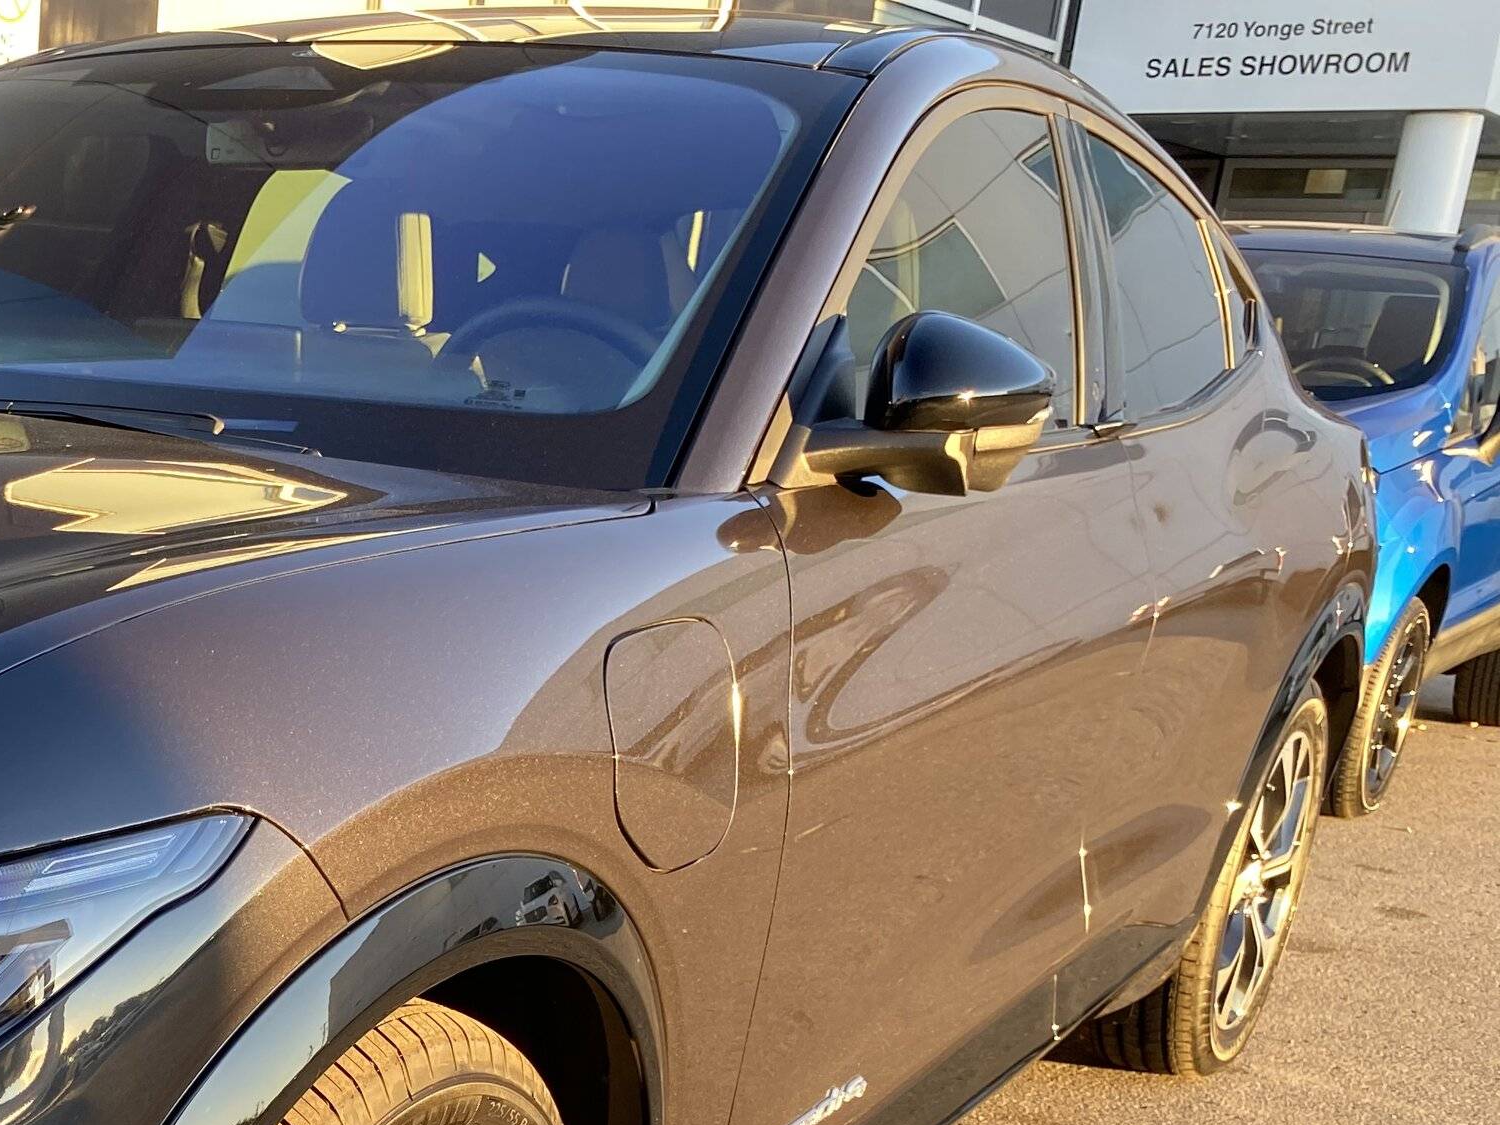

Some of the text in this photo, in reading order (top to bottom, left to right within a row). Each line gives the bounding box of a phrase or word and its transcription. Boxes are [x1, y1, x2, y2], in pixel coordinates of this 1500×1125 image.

[1193, 18, 1374, 41] 7120 Yonge Street
[1145, 52, 1410, 79] SALES SHOWROOM
